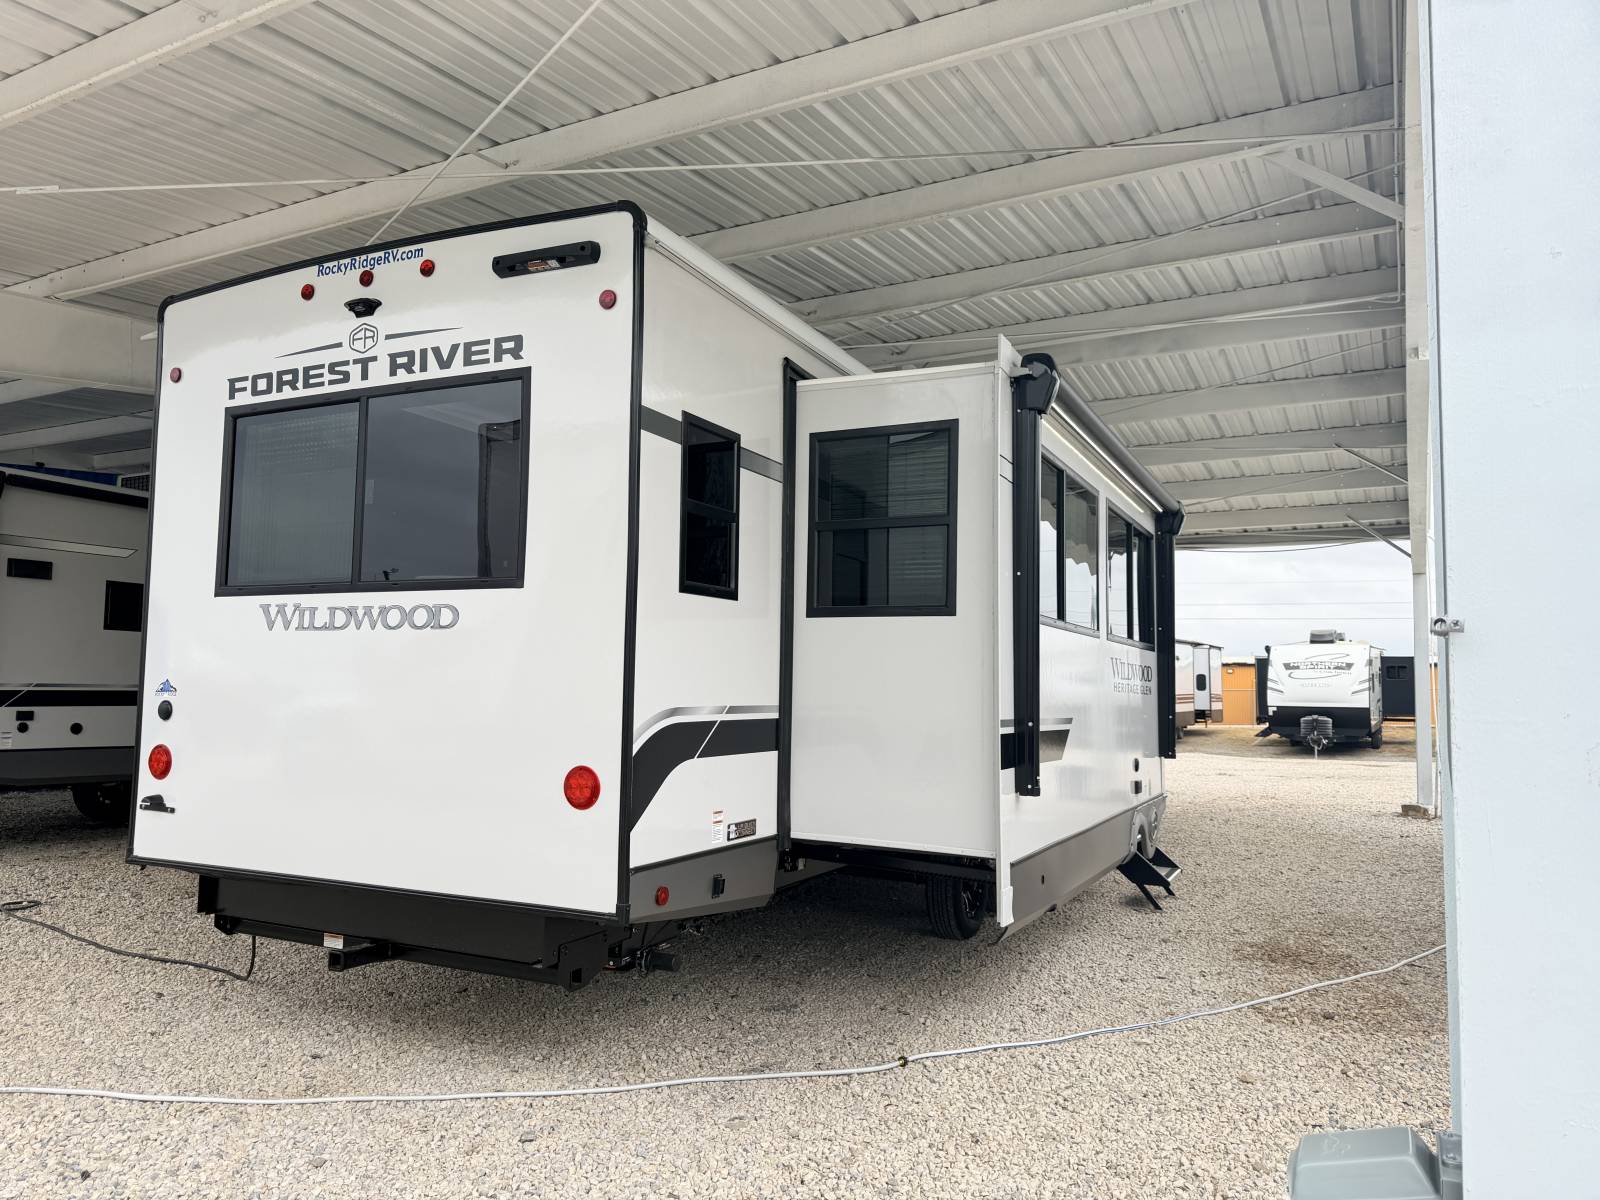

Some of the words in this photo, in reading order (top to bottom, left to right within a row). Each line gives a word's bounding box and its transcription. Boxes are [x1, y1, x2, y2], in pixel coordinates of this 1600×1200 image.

[317, 247, 424, 277] RockyRidgeRV.com
[227, 355, 378, 400] FOREST
[387, 334, 525, 377] RIVER
[259, 602, 460, 631] WILDWOOD
